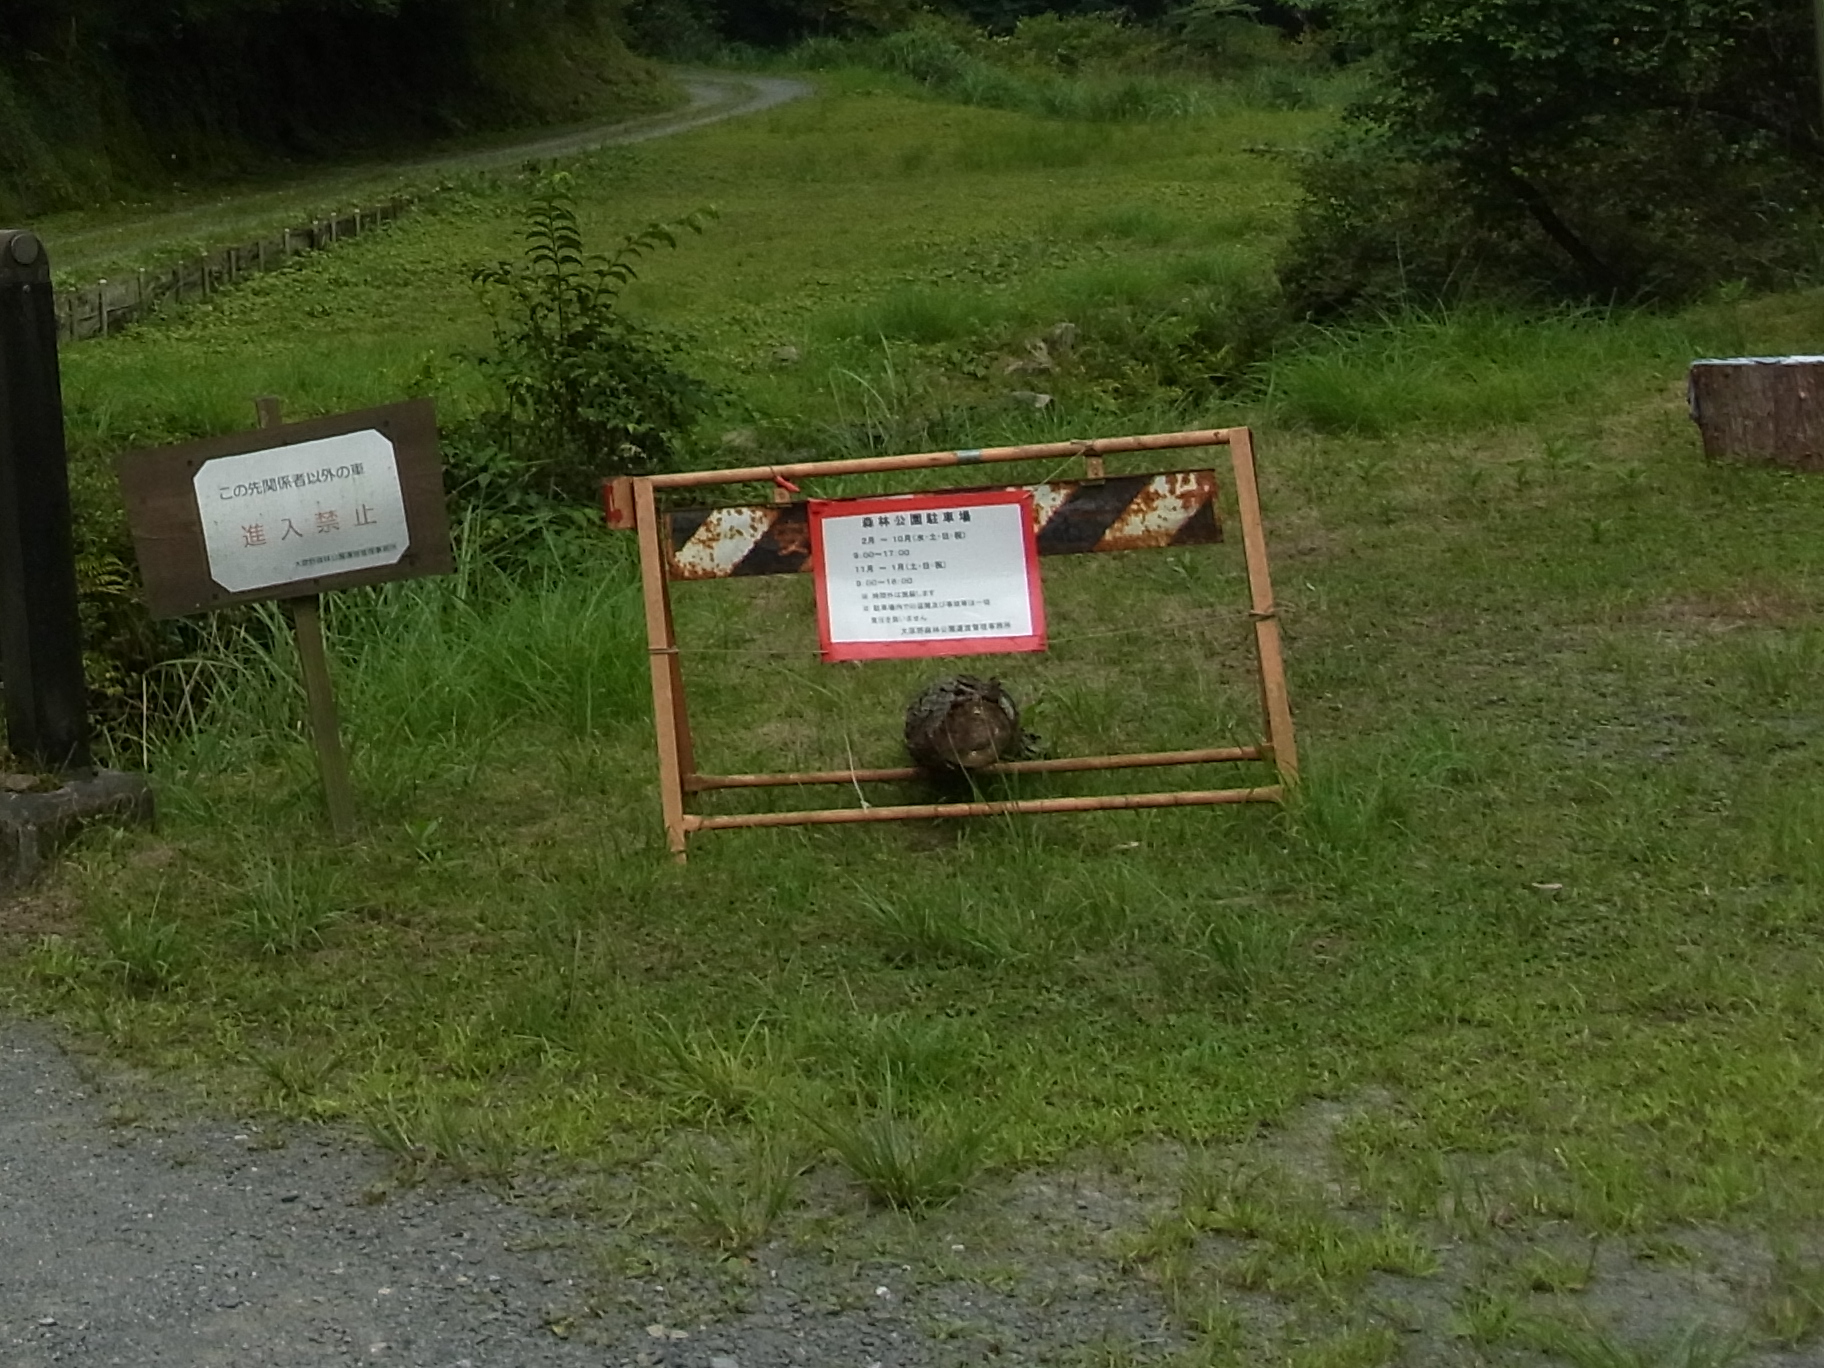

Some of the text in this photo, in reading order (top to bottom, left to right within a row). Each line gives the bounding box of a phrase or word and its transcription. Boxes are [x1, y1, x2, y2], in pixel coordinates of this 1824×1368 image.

[218, 462, 365, 501] この先関係者以外の車
[241, 503, 378, 549] 進入禁止
[862, 510, 971, 528] 森林公園駐車場
